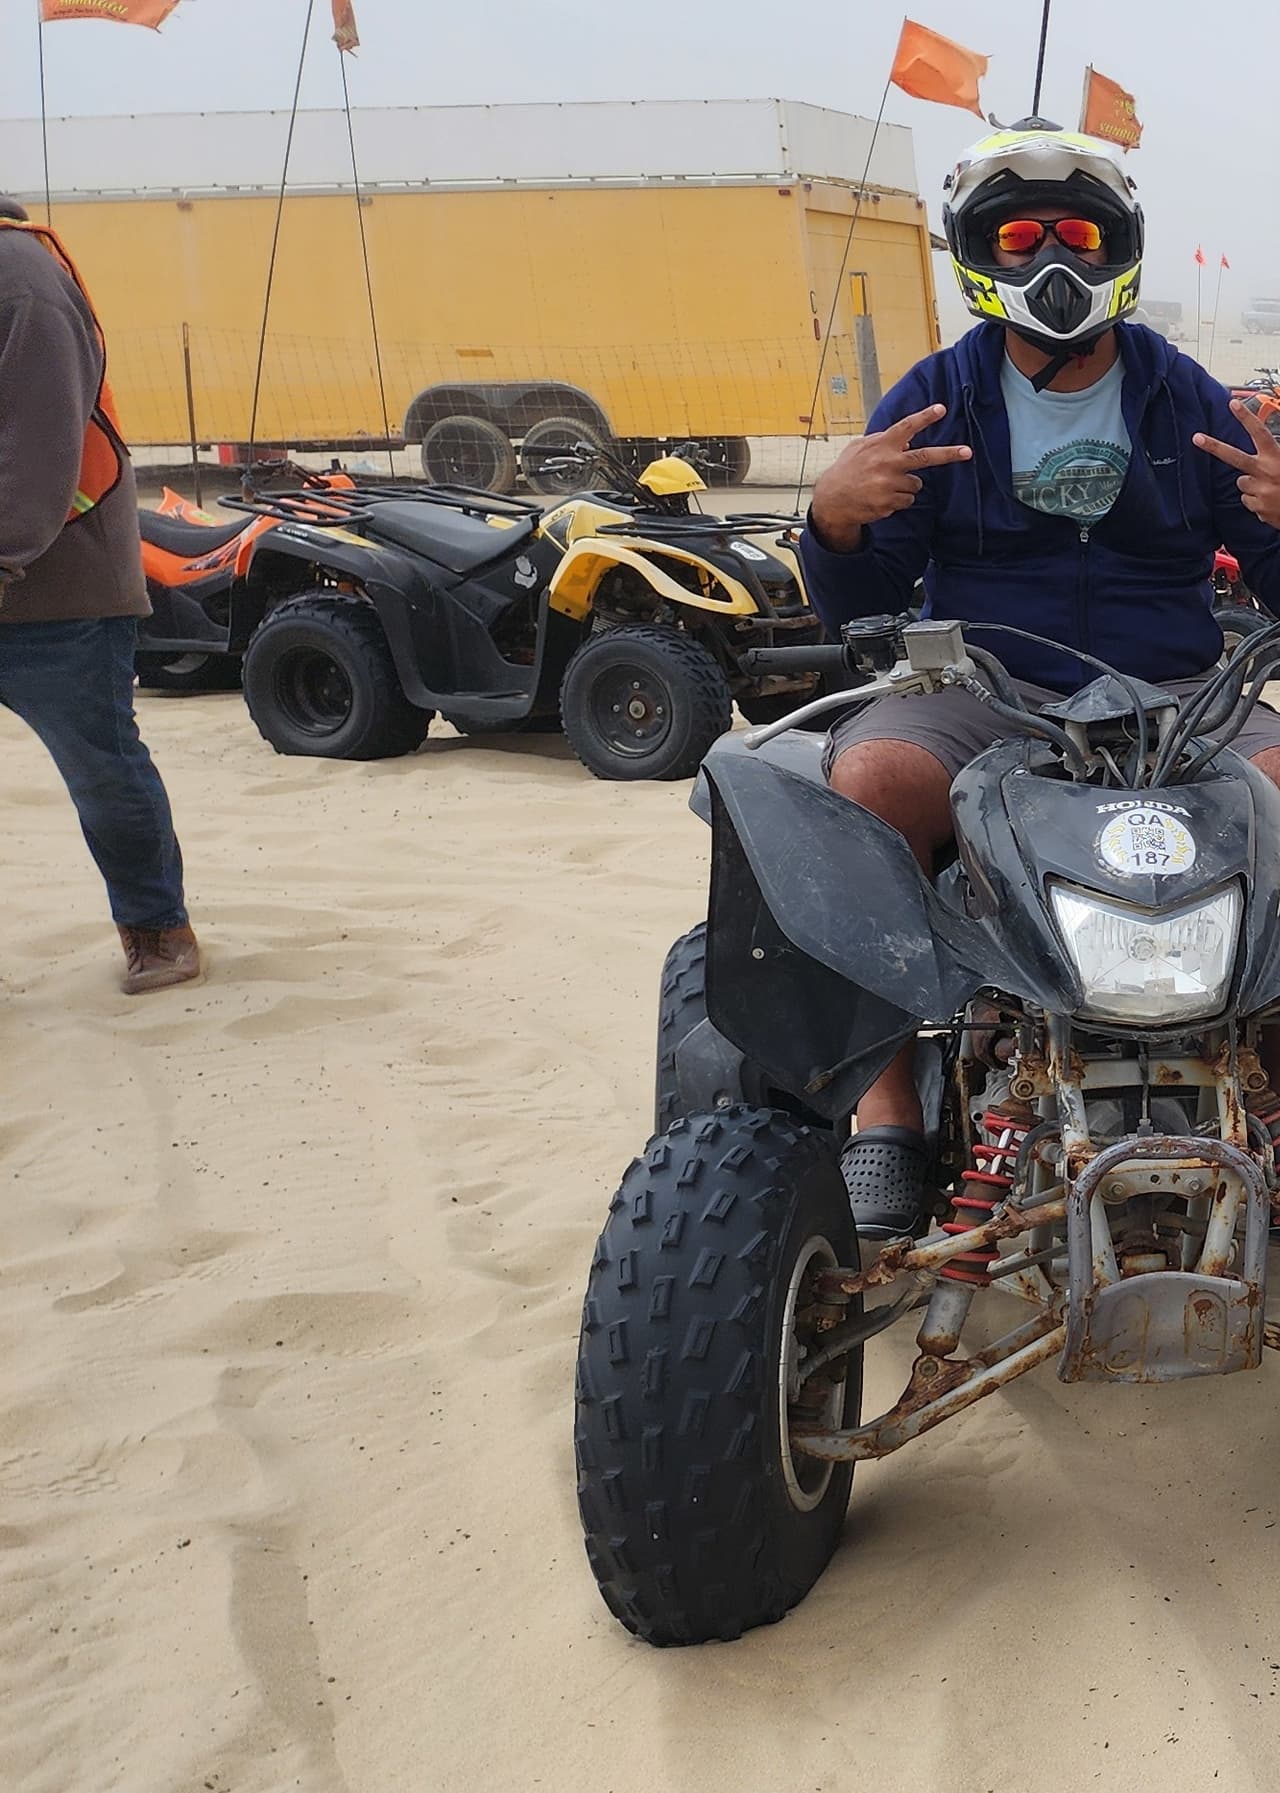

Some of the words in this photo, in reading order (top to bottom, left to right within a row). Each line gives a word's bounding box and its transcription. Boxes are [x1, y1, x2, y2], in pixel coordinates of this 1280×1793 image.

[1018, 481, 1091, 512] UCKY
[1096, 800, 1193, 818] HONDA
[1127, 813, 1165, 828] QA
[1132, 852, 1170, 867] 187
